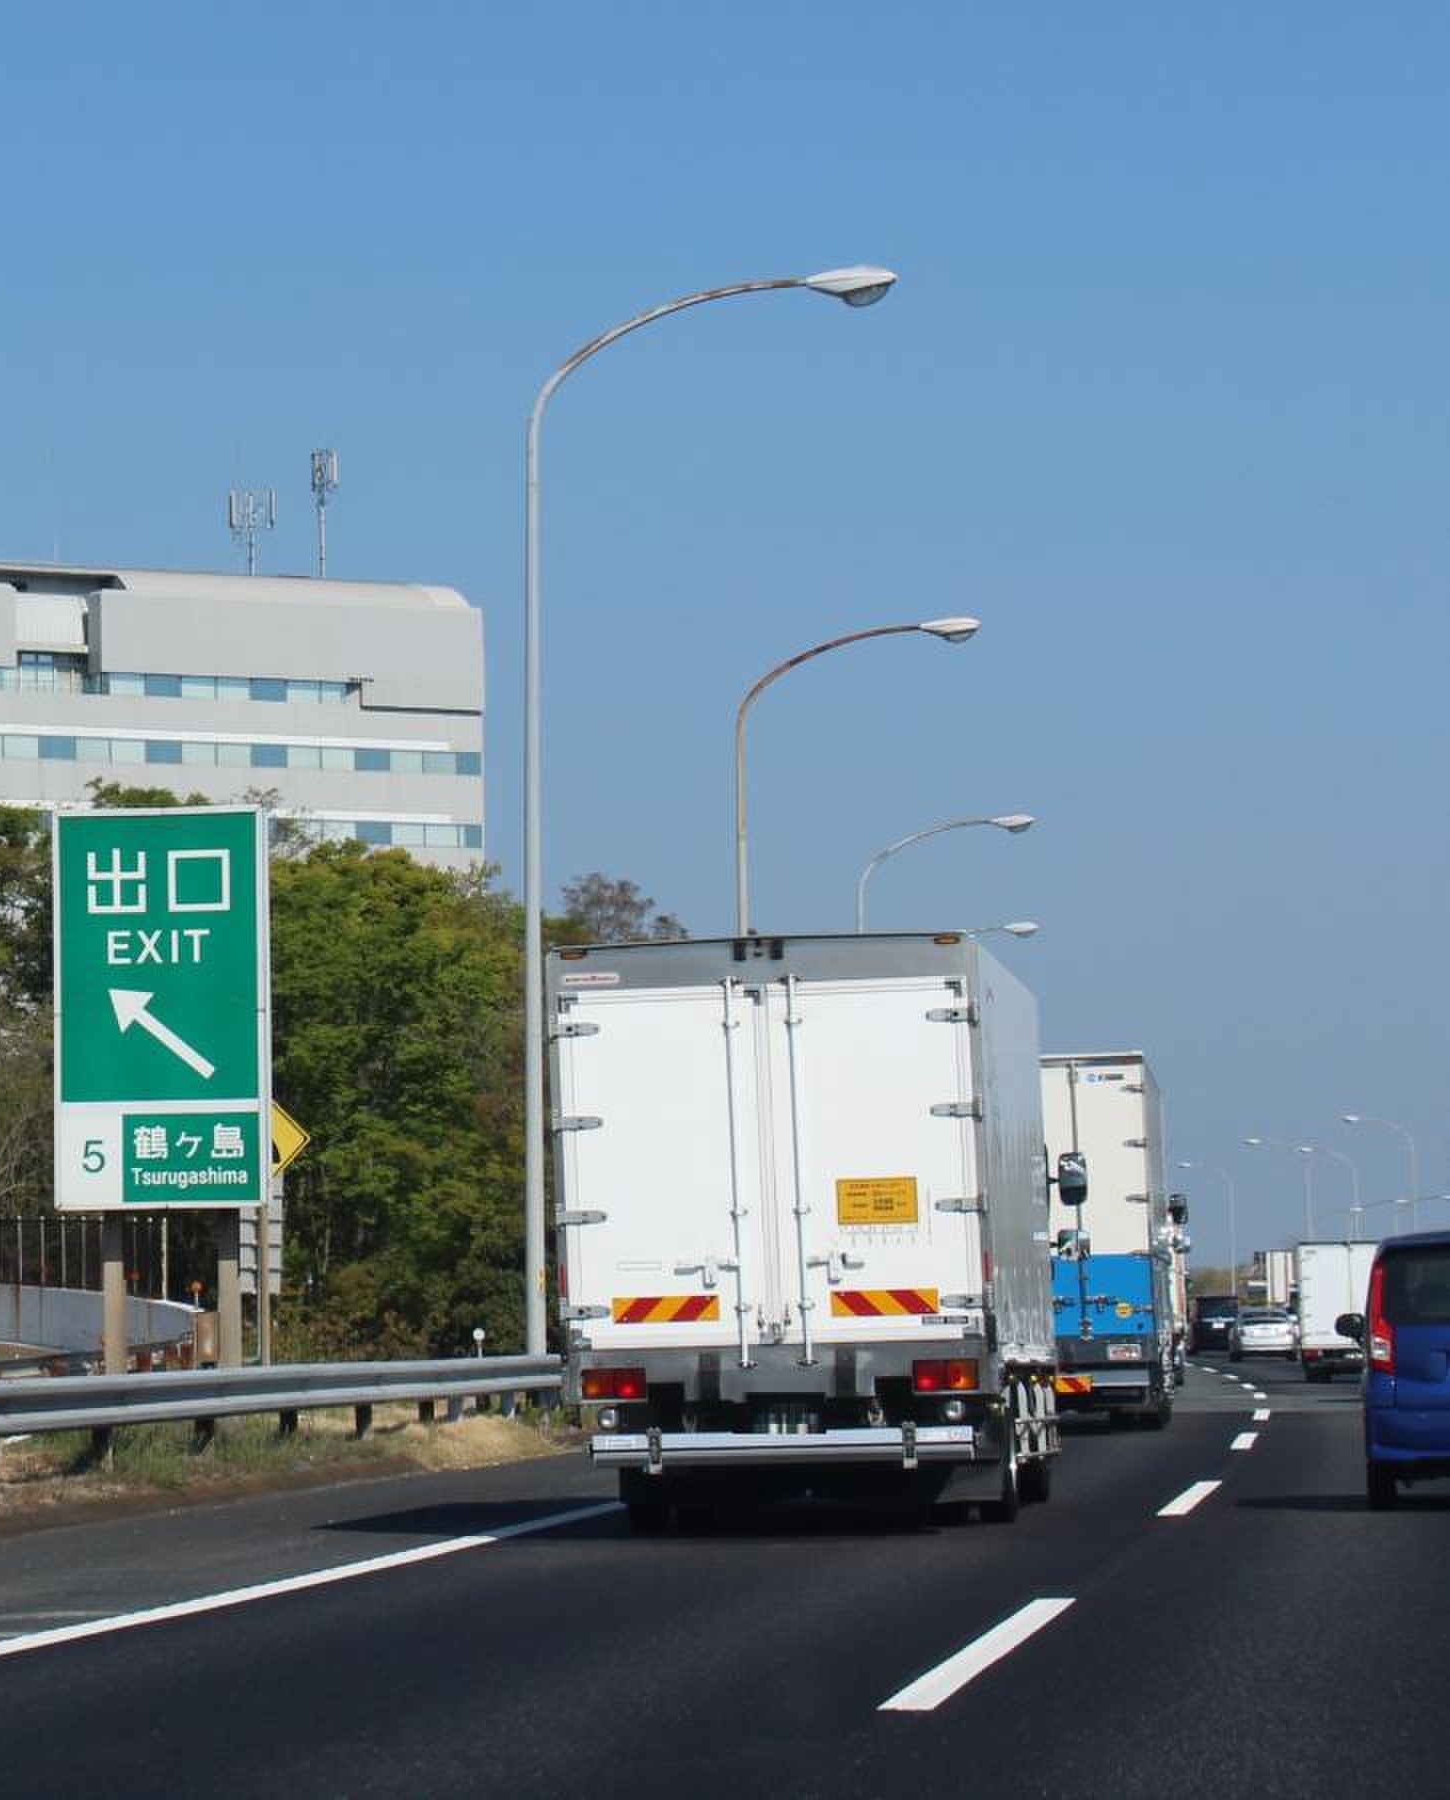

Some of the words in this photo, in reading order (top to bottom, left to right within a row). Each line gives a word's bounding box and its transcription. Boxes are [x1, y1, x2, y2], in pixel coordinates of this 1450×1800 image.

[87, 848, 231, 913] 出口
[108, 929, 210, 964] EXIT
[82, 1141, 105, 1173] 5
[131, 1167, 249, 1189] Tsurugashima
